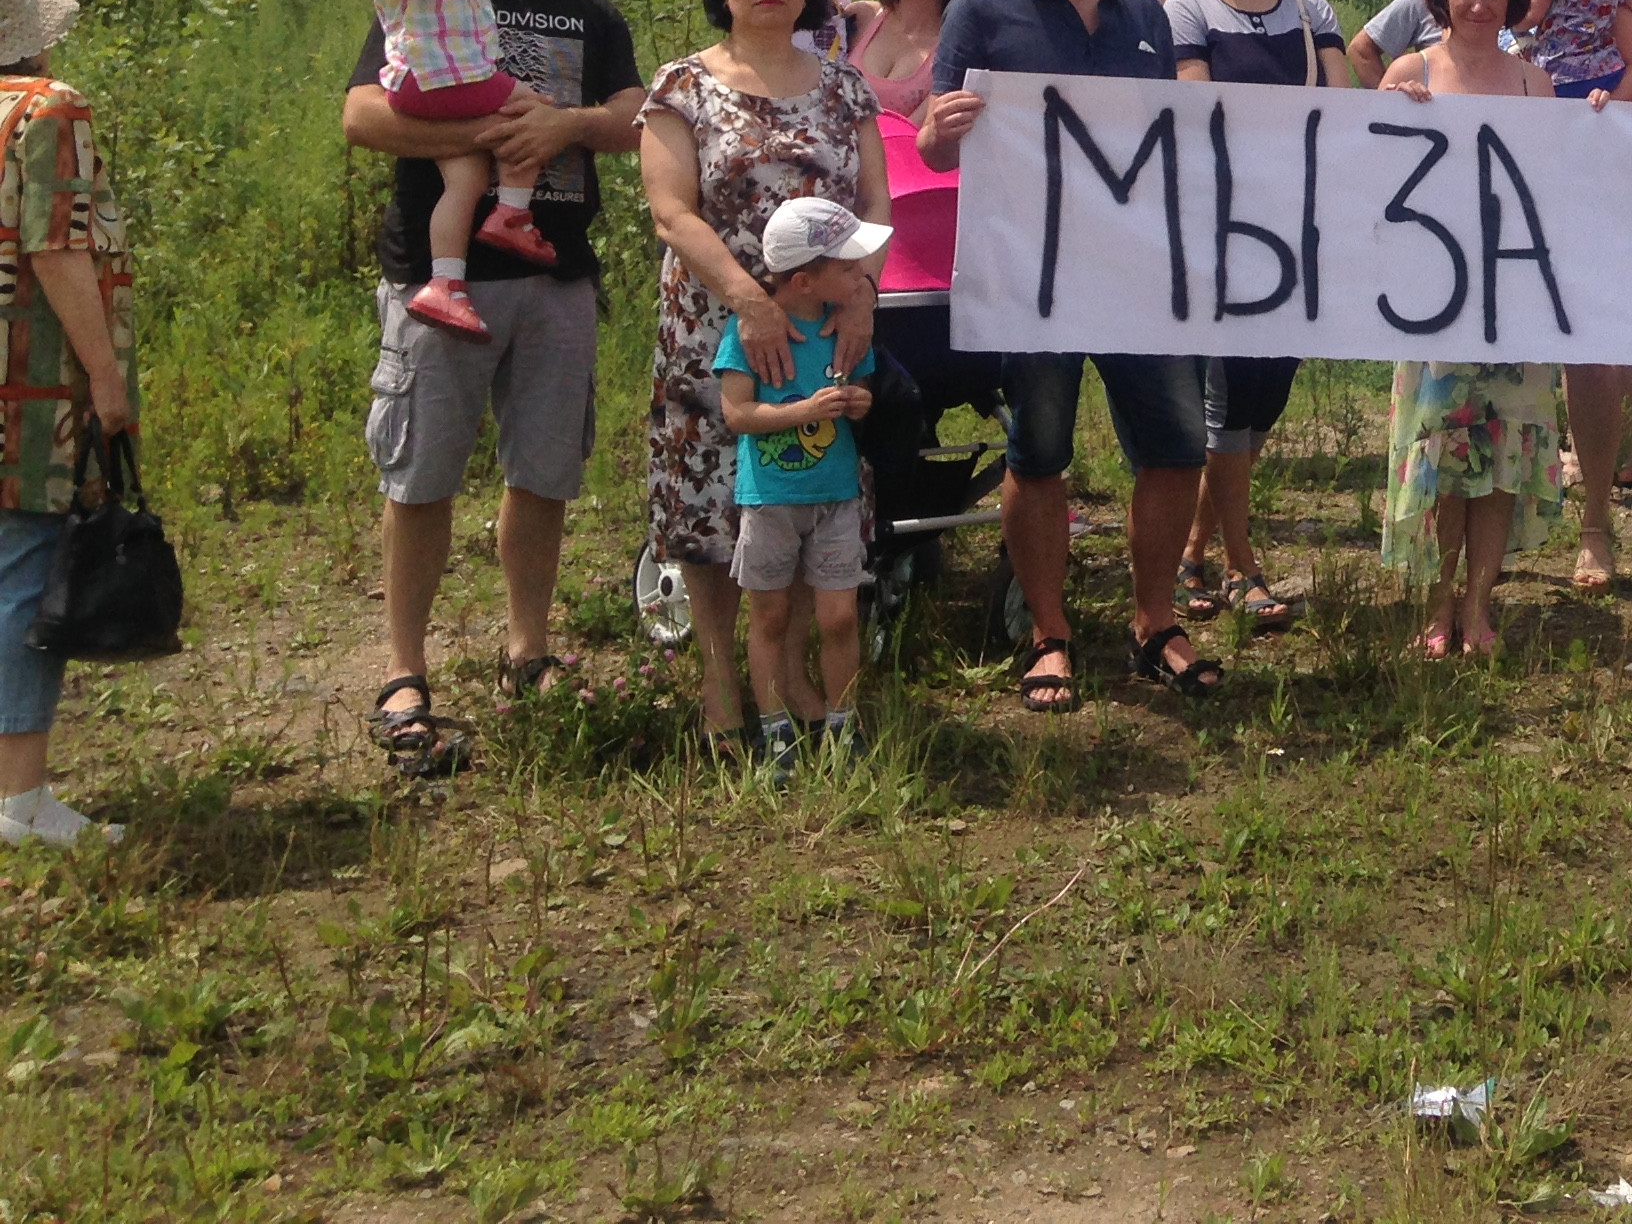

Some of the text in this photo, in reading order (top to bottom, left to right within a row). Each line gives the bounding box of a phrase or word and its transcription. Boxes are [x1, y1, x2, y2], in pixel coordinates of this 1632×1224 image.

[496, 9, 585, 33] DIVISION
[531, 188, 585, 203] EASURES
[1037, 85, 1573, 344] МЫ ЗА
